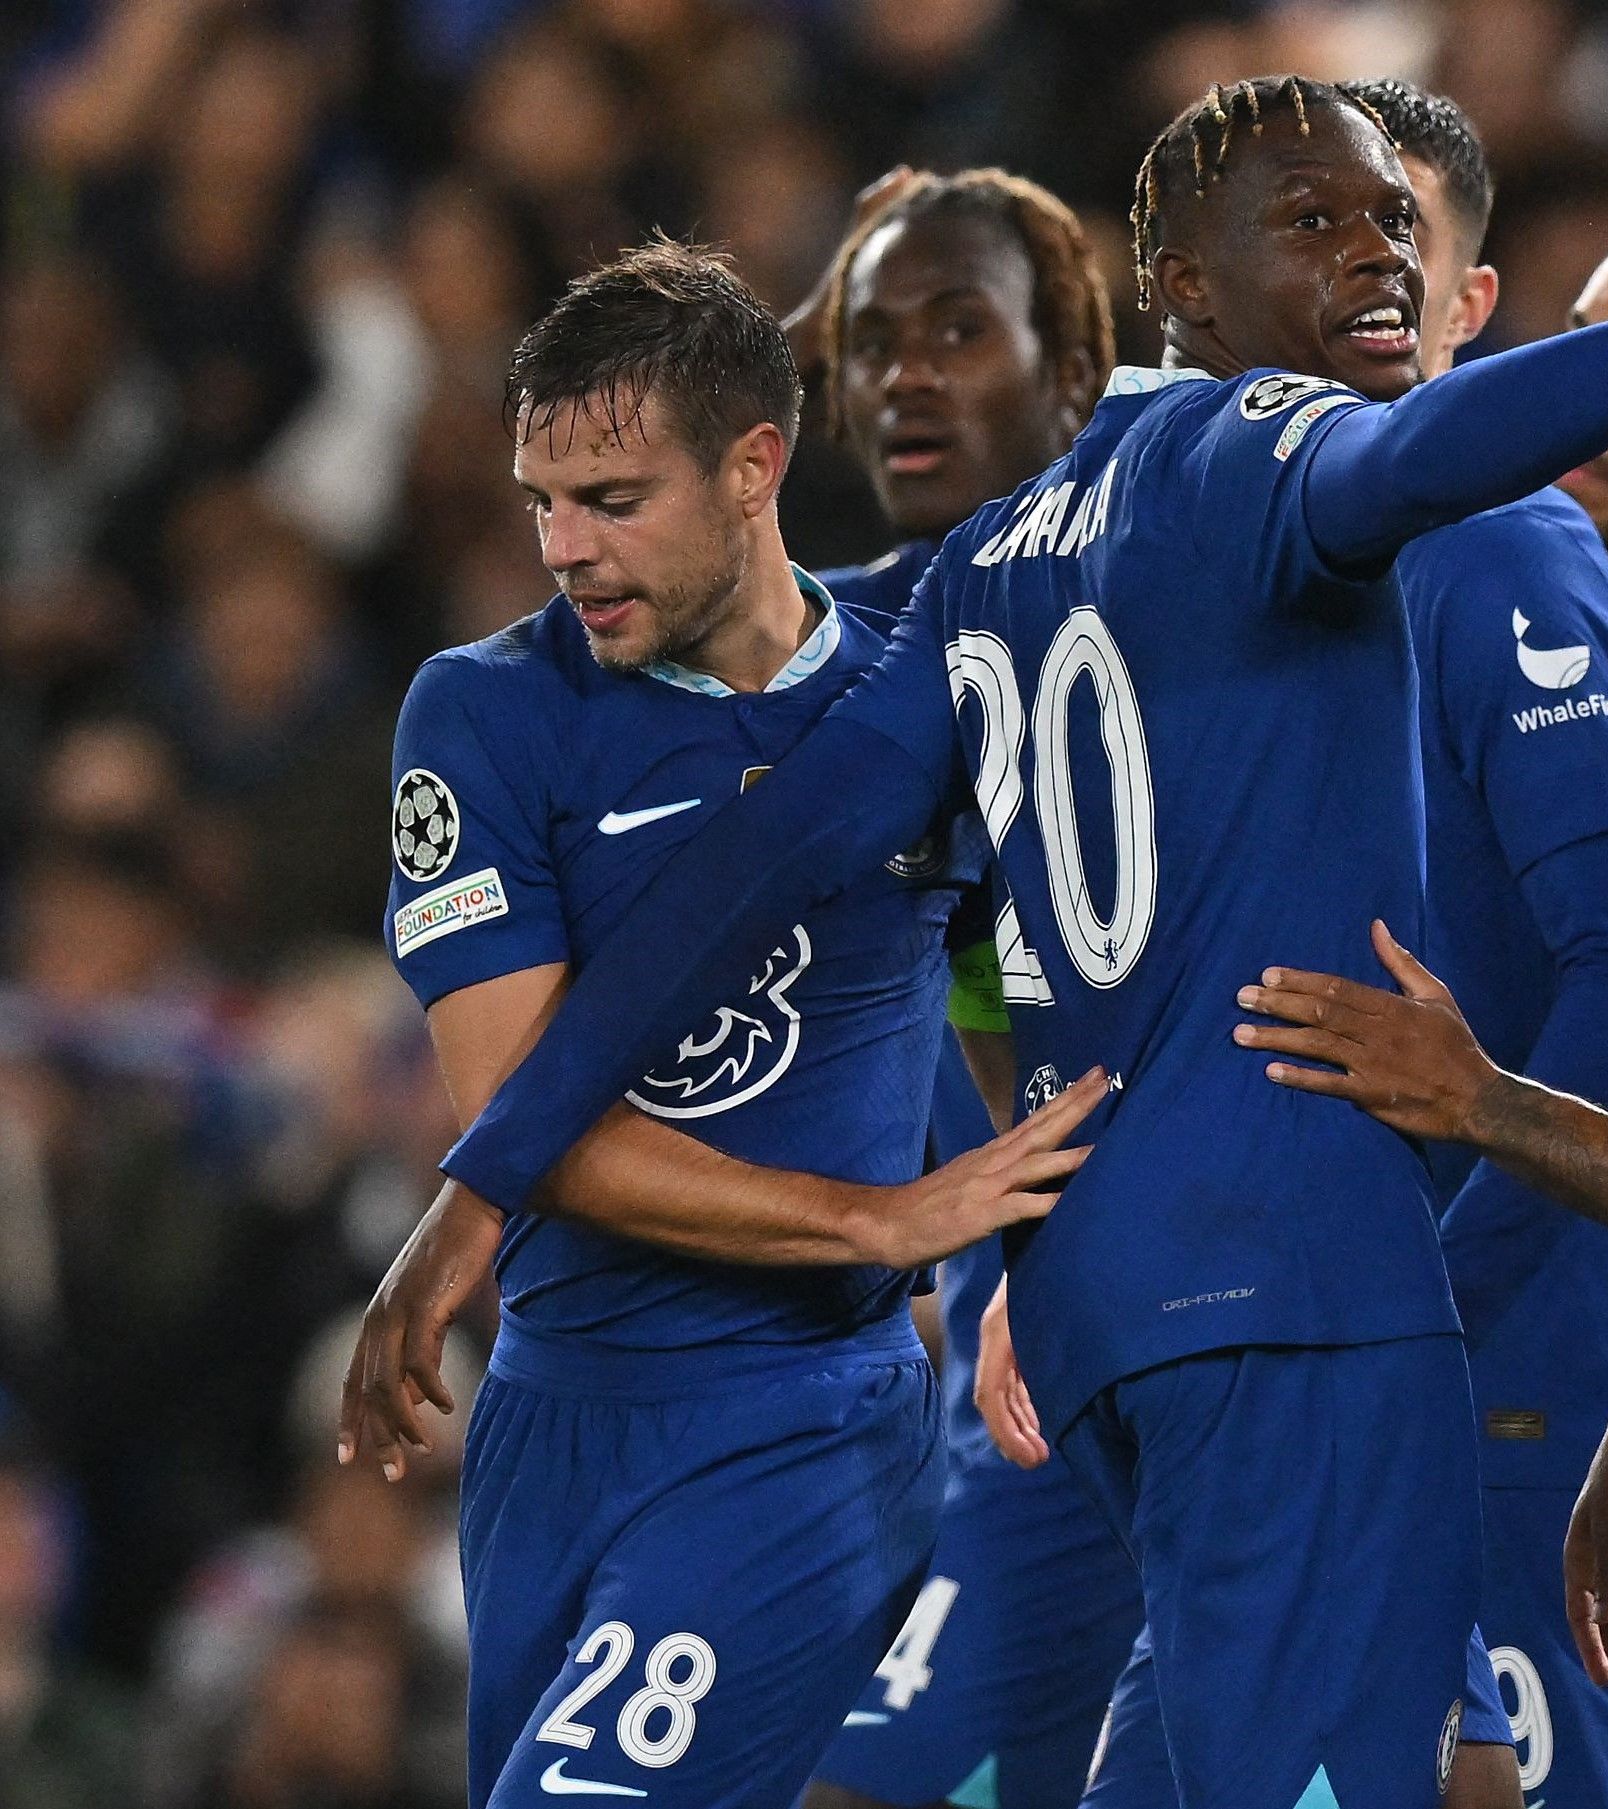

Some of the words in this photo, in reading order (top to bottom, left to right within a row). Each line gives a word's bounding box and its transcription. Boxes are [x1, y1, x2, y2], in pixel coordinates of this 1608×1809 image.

[945, 605, 1157, 1007] 20
[397, 883, 500, 942] FOUNDATION
[535, 1620, 717, 1768] 28
[1487, 1645, 1554, 1791] 9
